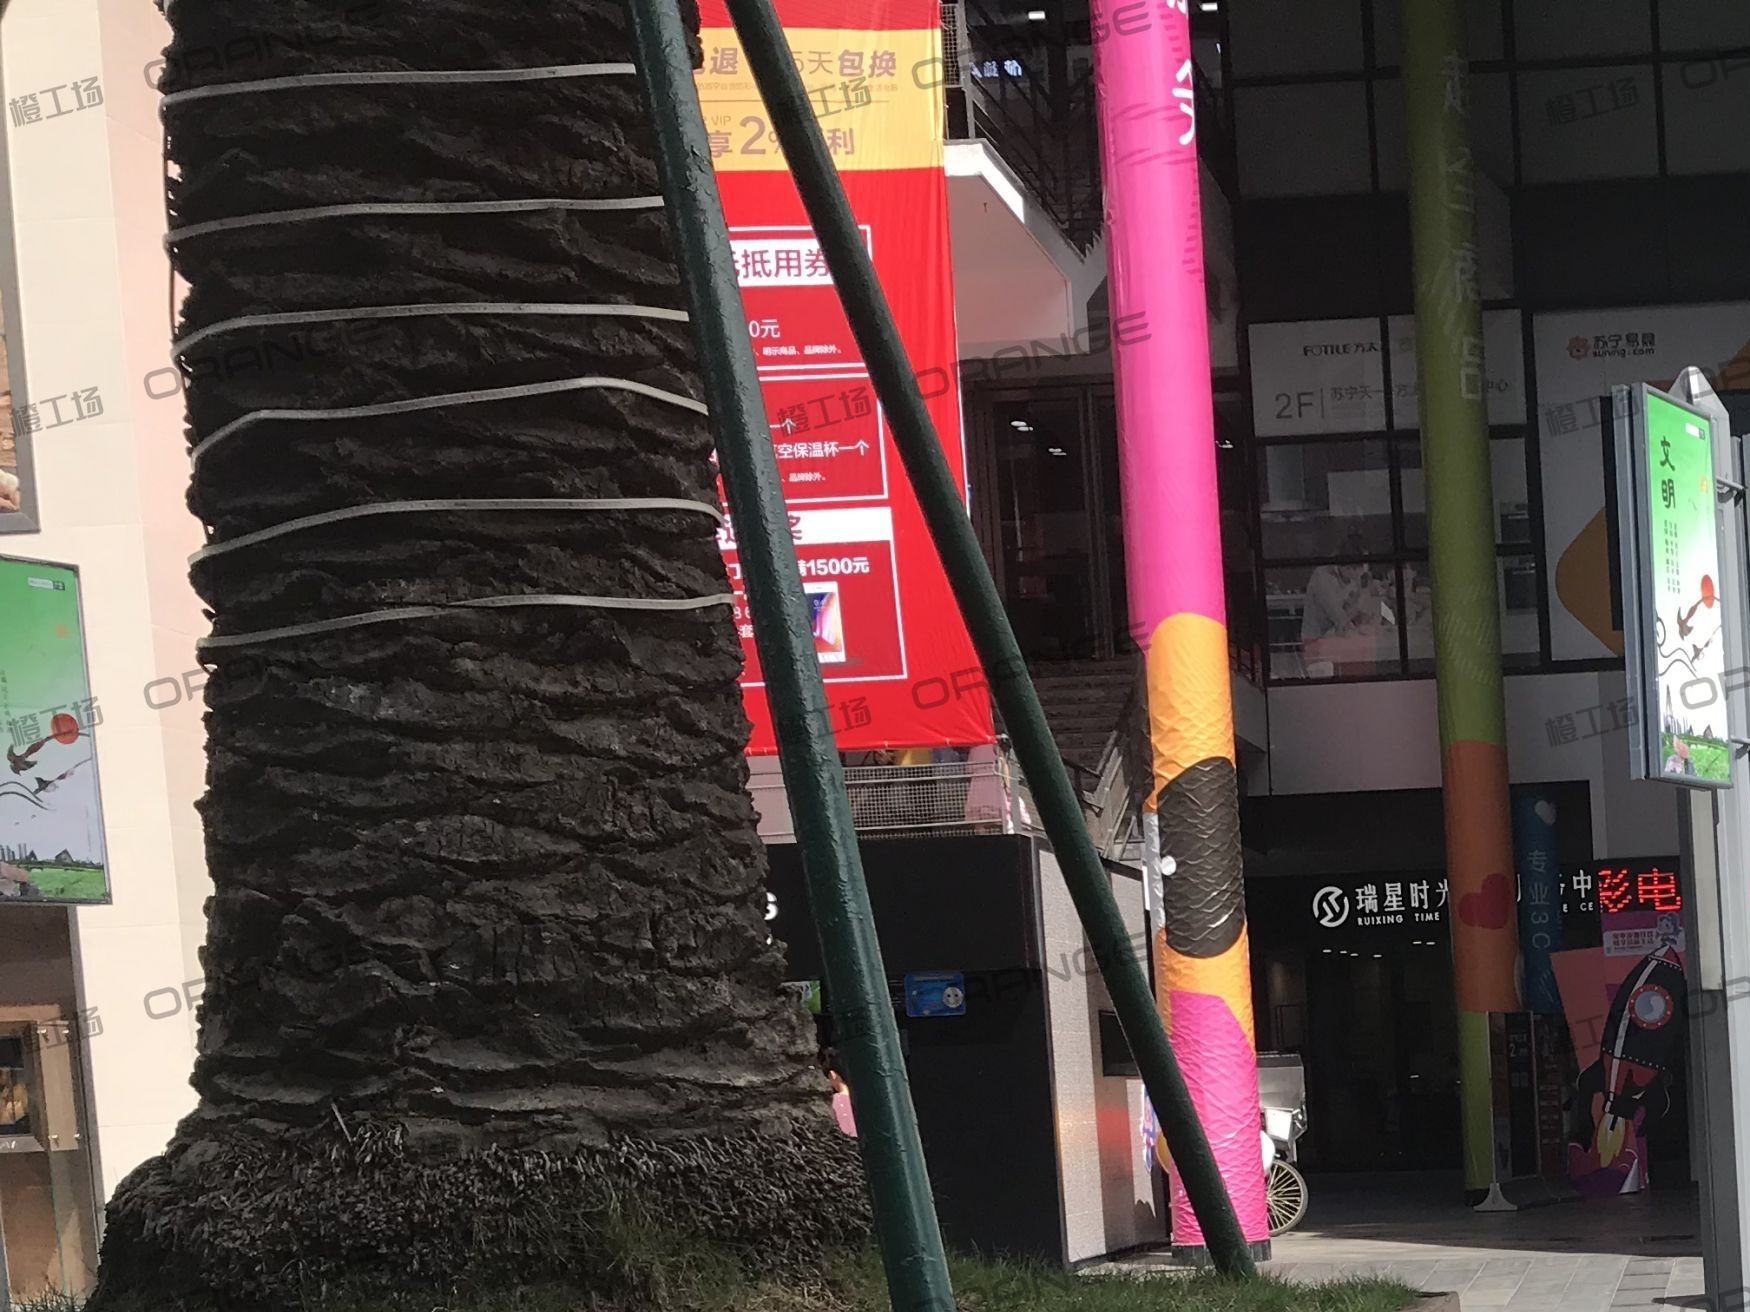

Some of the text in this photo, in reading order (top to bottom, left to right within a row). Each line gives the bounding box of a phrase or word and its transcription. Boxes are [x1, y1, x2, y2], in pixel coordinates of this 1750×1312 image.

[731, 248, 829, 279] 抵用券
[1274, 391, 1315, 420] 2F
[773, 439, 870, 459] 空保温杯一个
[1660, 435, 1676, 511] 文明
[1357, 914, 1404, 926] RUIXING
[1415, 911, 1441, 922] TIME
